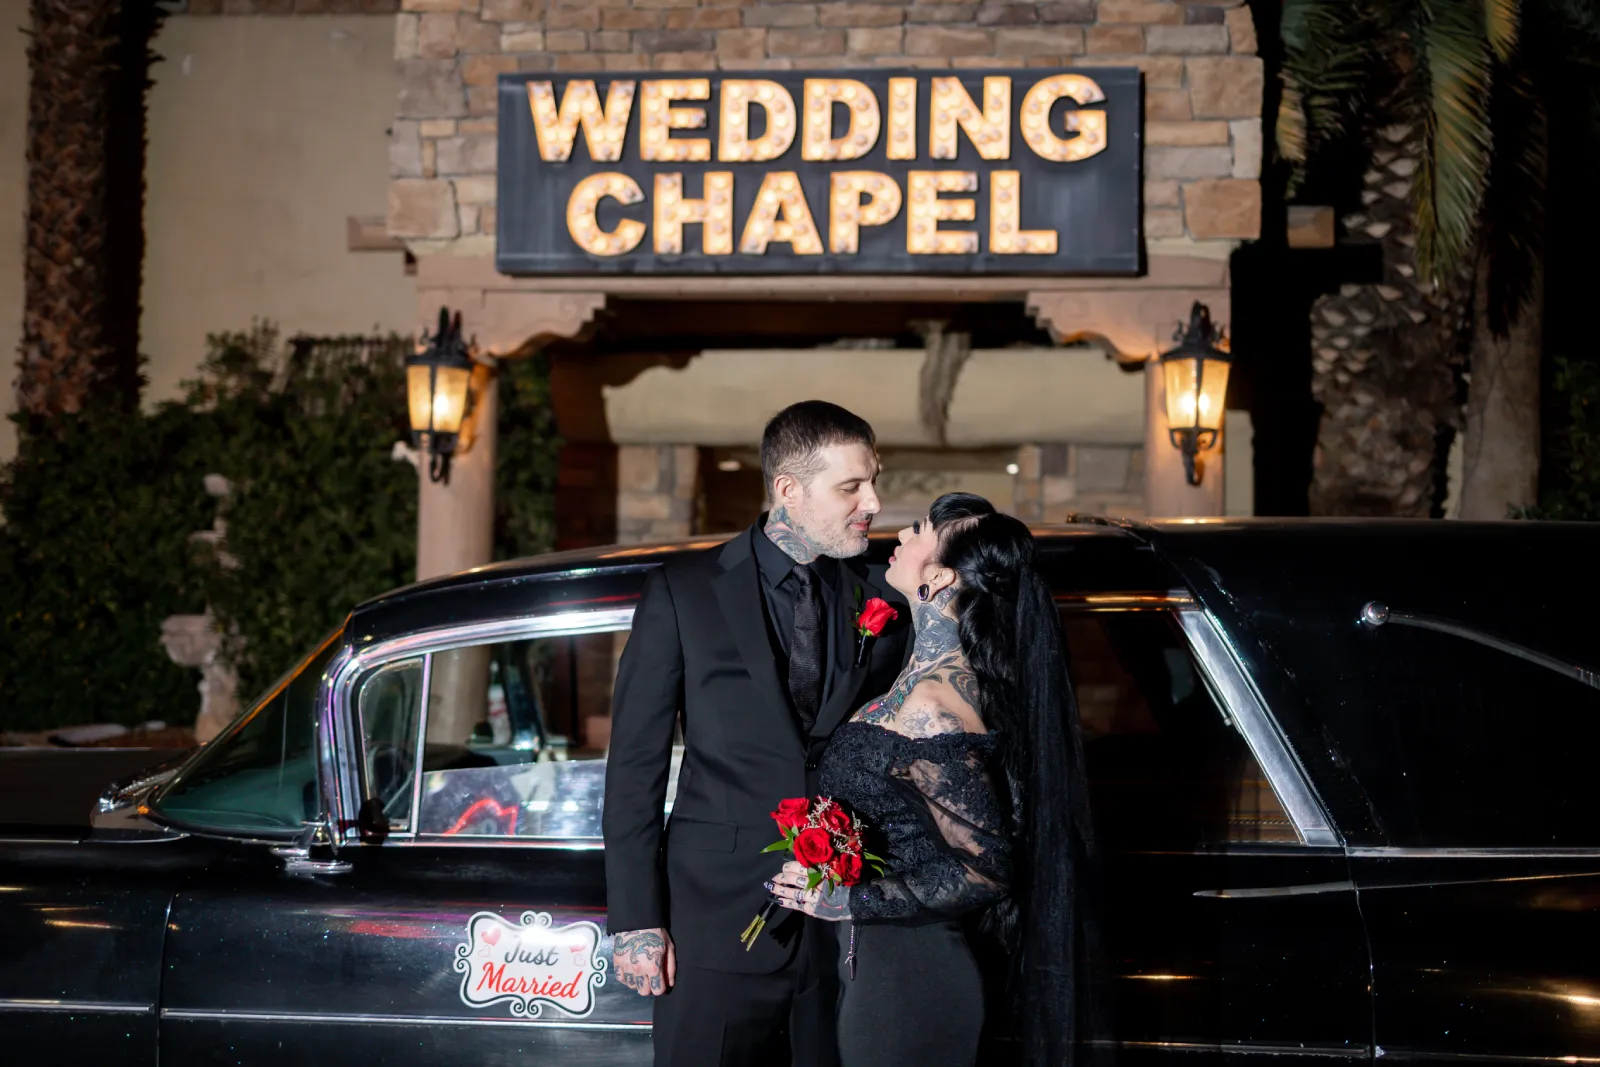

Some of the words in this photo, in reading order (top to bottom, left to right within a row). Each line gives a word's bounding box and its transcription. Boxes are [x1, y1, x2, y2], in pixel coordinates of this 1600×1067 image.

[527, 74, 1108, 162] WEDDING
[566, 170, 1058, 256] CHAPEL
[477, 961, 583, 998] Married
[504, 937, 559, 966] Just
